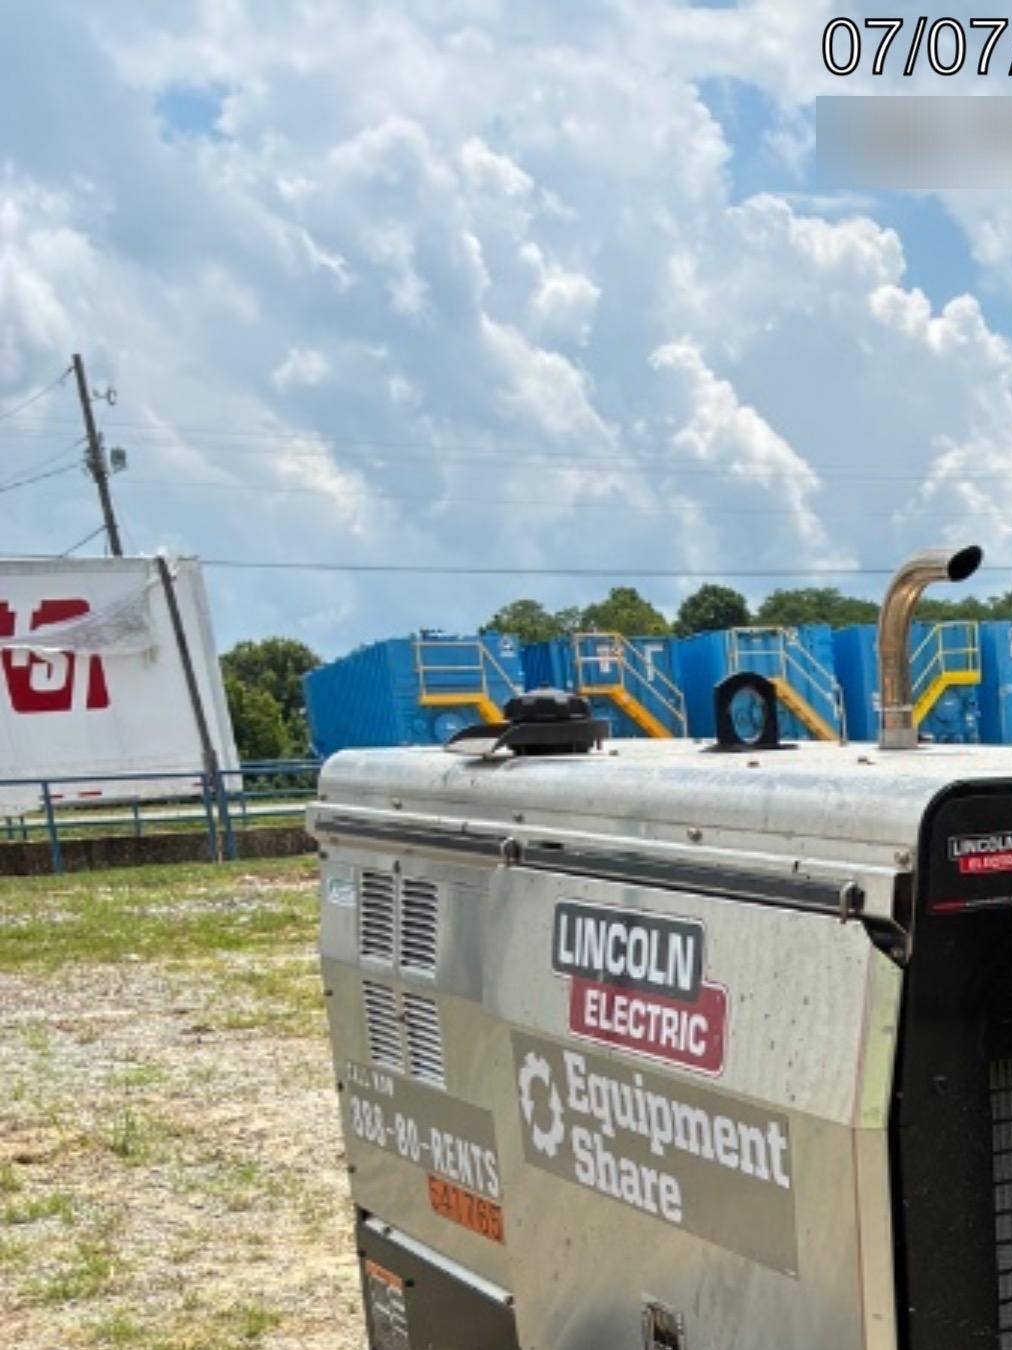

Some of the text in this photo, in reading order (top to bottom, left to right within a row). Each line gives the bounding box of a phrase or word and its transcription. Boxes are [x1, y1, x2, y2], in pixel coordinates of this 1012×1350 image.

[559, 914, 694, 991] LINCOLN
[584, 988, 709, 1057] ELECTRIC
[563, 1050, 790, 1189] Equipment
[571, 1126, 683, 1224] Share
